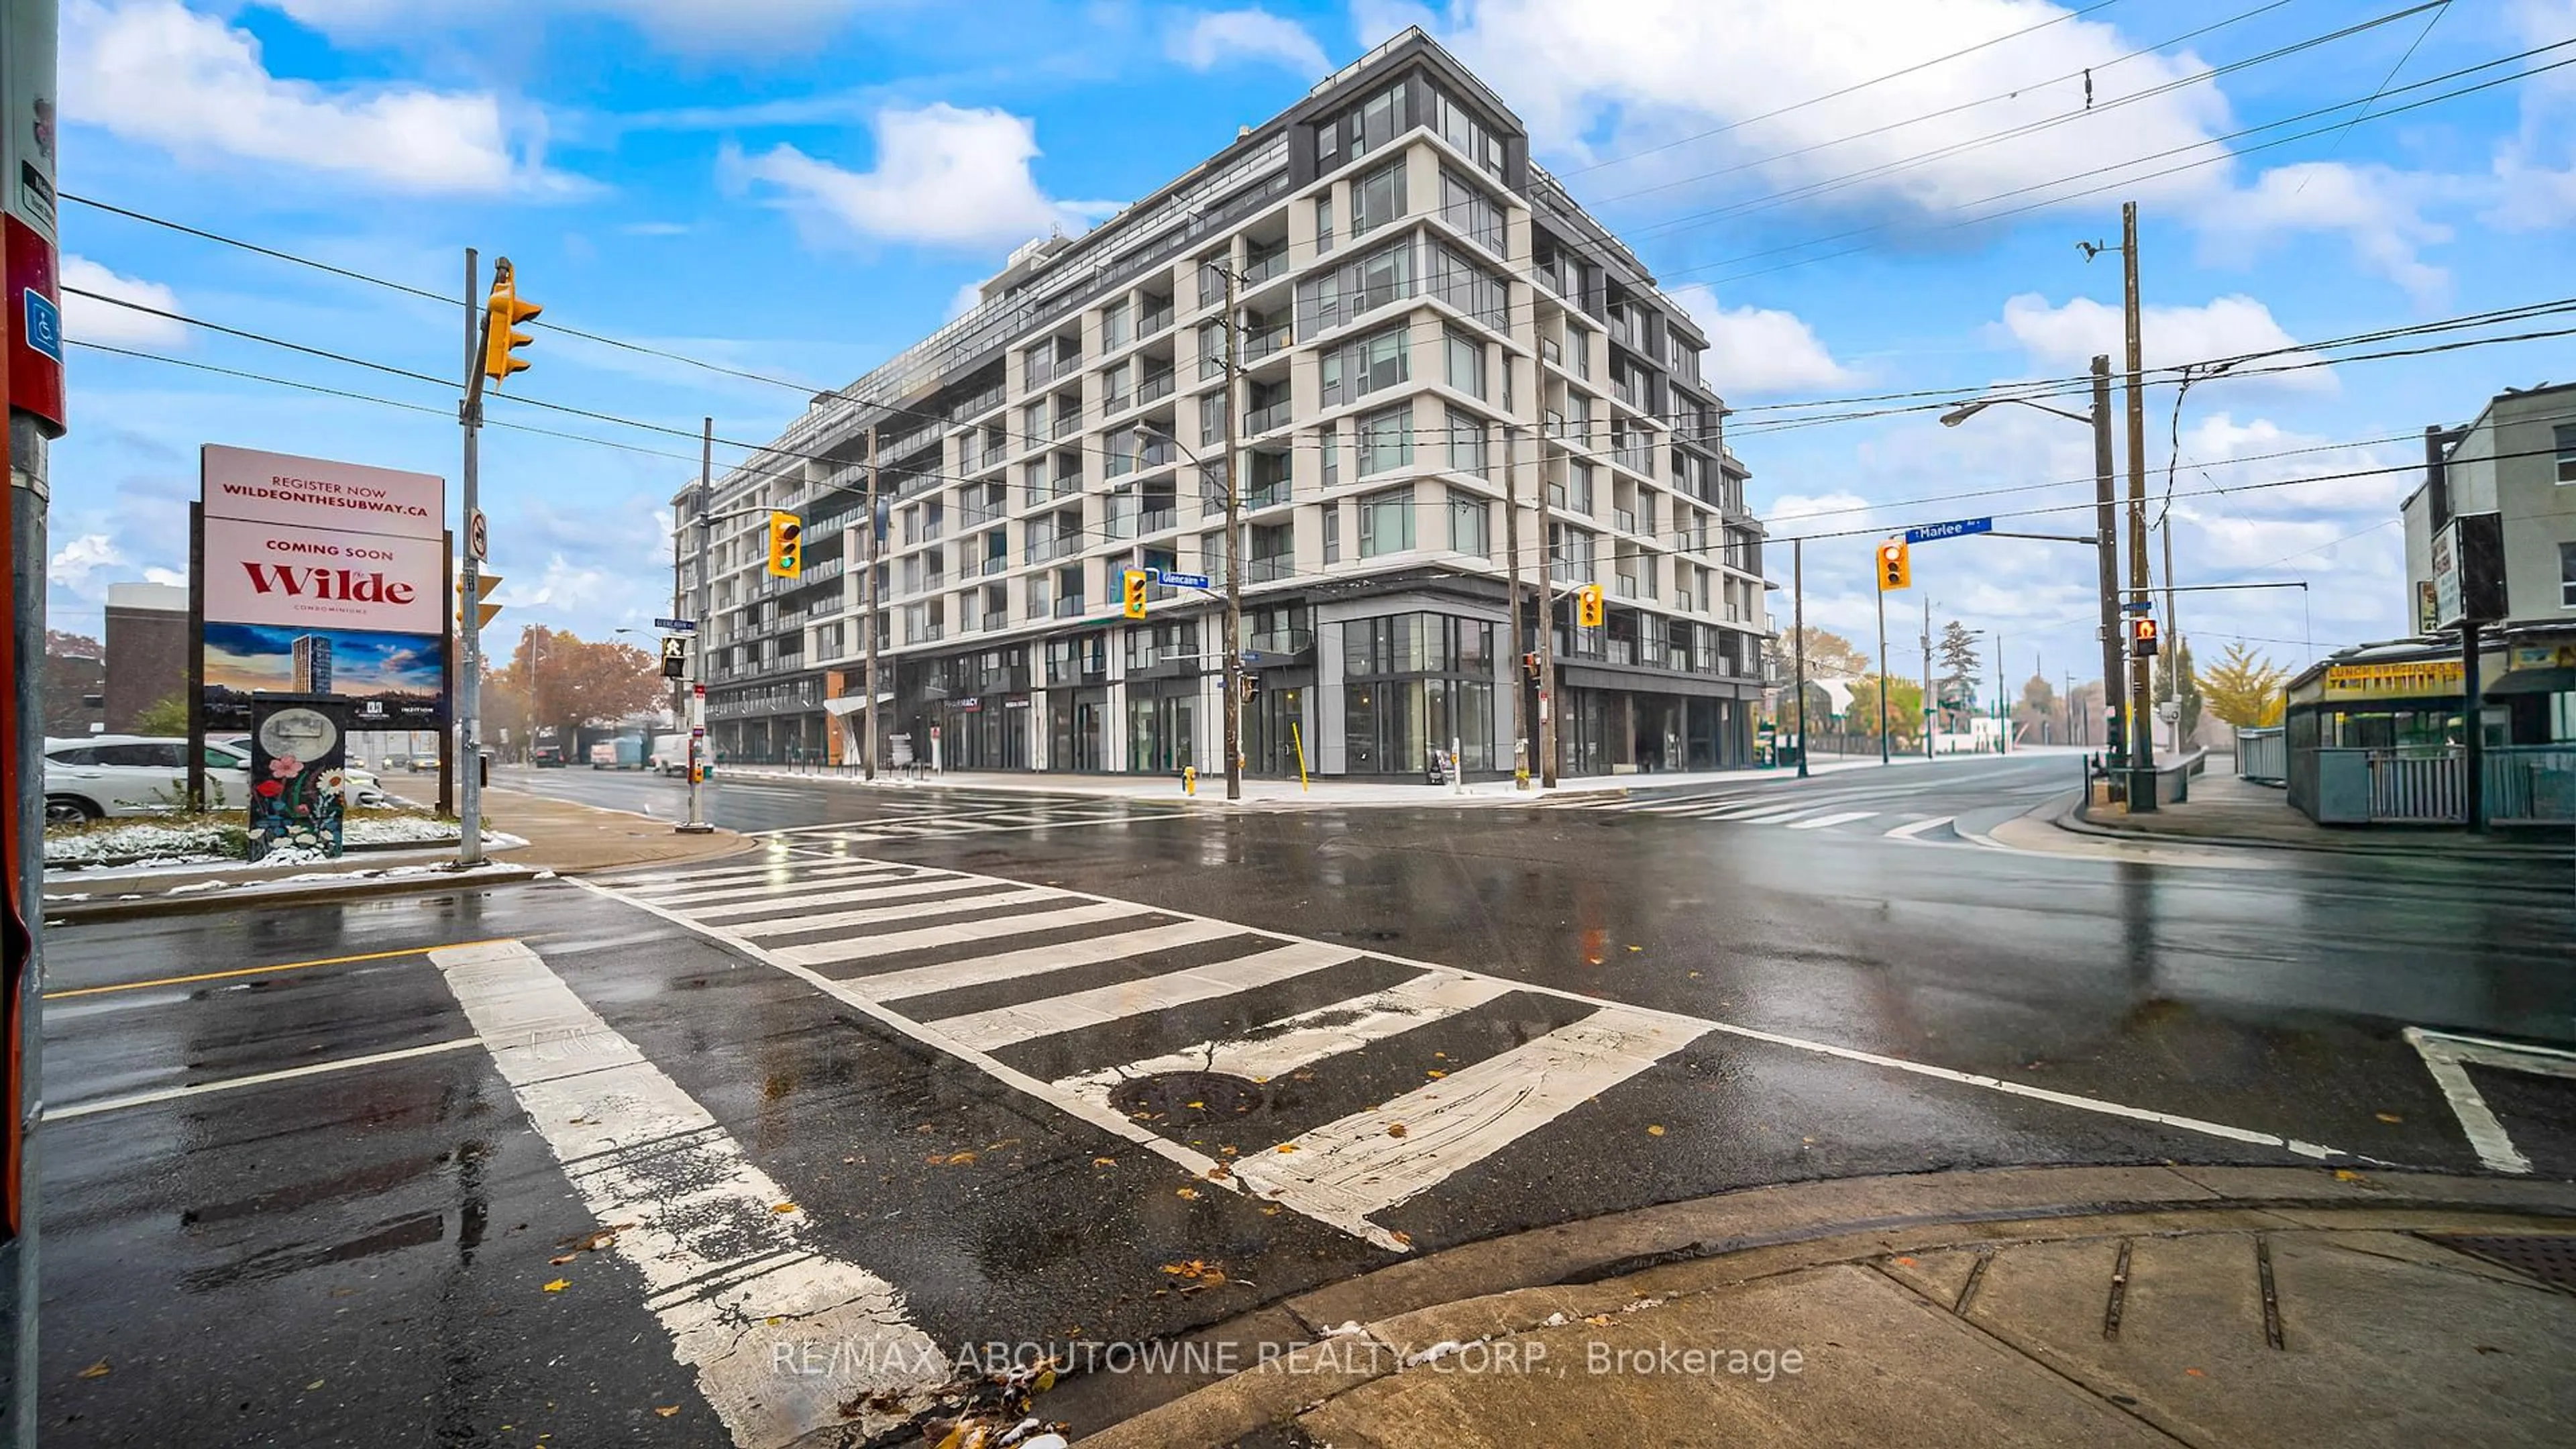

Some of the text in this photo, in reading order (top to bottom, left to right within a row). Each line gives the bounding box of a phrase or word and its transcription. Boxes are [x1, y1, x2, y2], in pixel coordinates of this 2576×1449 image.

[272, 476, 387, 498] REGISTER NOW
[223, 484, 429, 517] WILDEONTHESUBWAY.CA
[1920, 524, 1963, 539] Marlee
[266, 539, 394, 561] COMING SOON
[241, 561, 417, 604] Wilde
